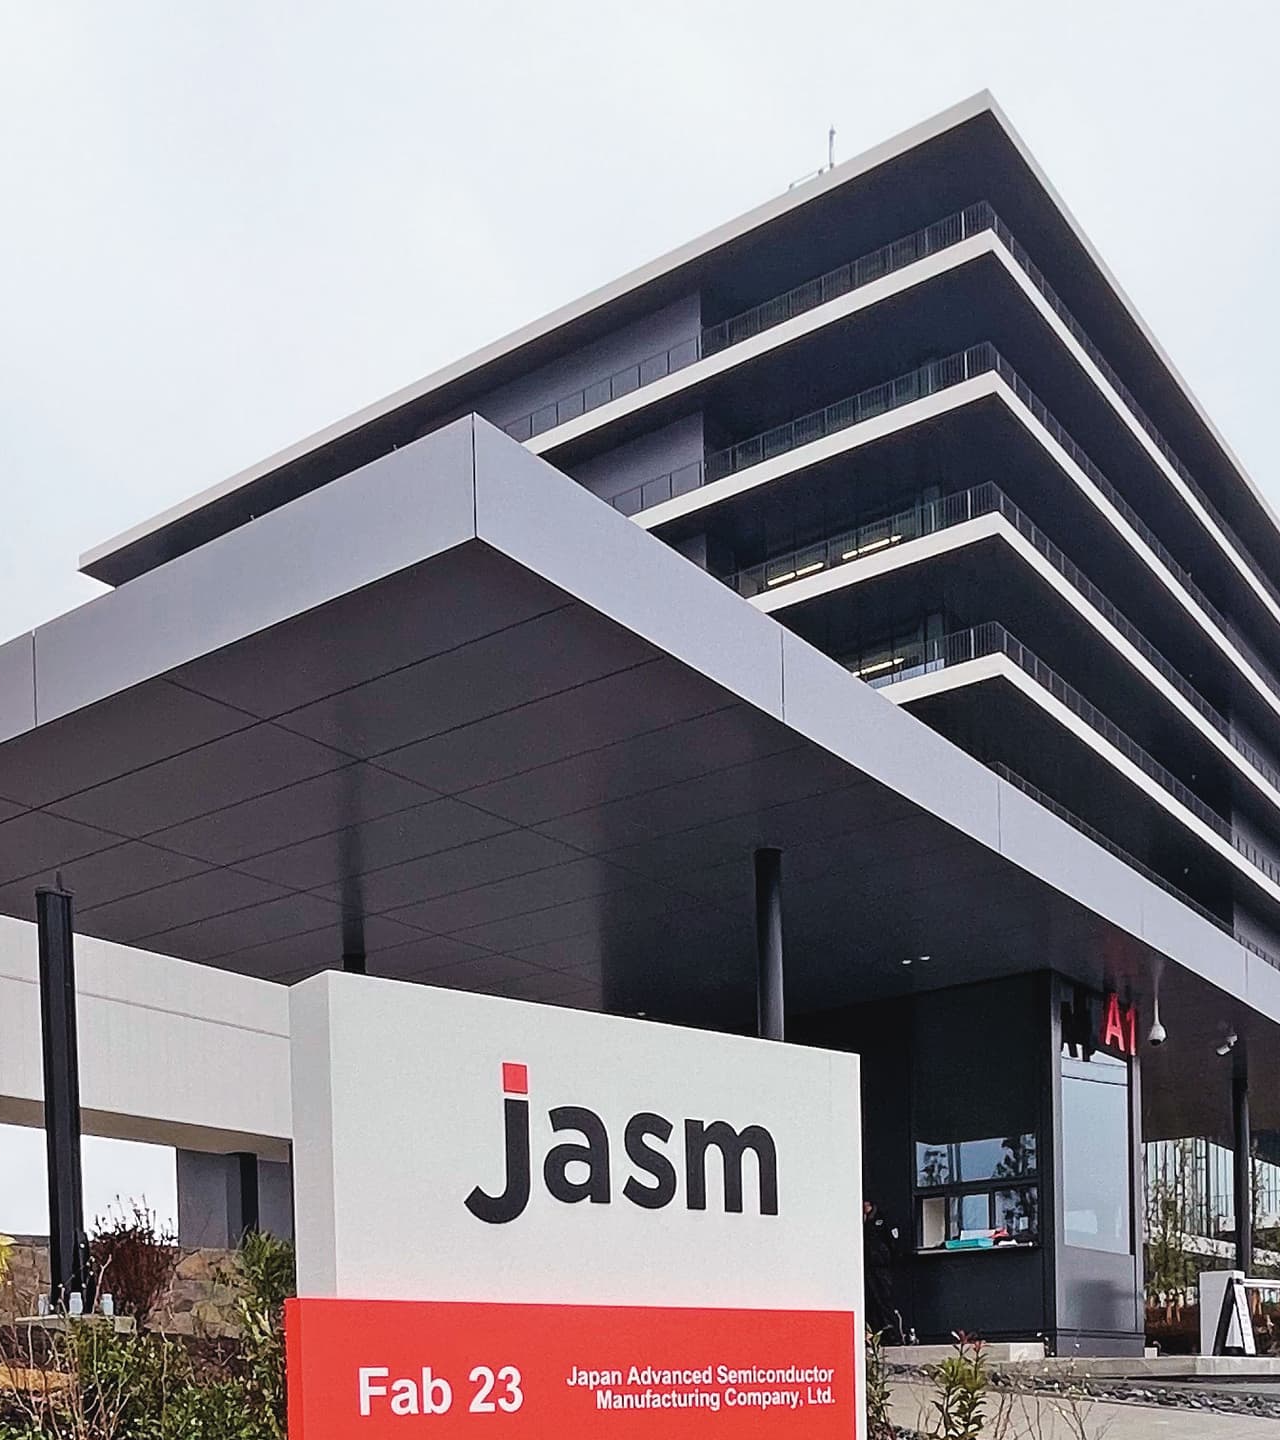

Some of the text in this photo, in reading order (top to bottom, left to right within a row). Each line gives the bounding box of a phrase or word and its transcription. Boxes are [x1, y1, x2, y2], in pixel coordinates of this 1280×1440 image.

[464, 1062, 779, 1224] jasm
[359, 1366, 523, 1416] Fab 23
[566, 1364, 834, 1390] Japan Advanced Semiconductor
[596, 1385, 836, 1411] Manufacturing Company, Ltd.
